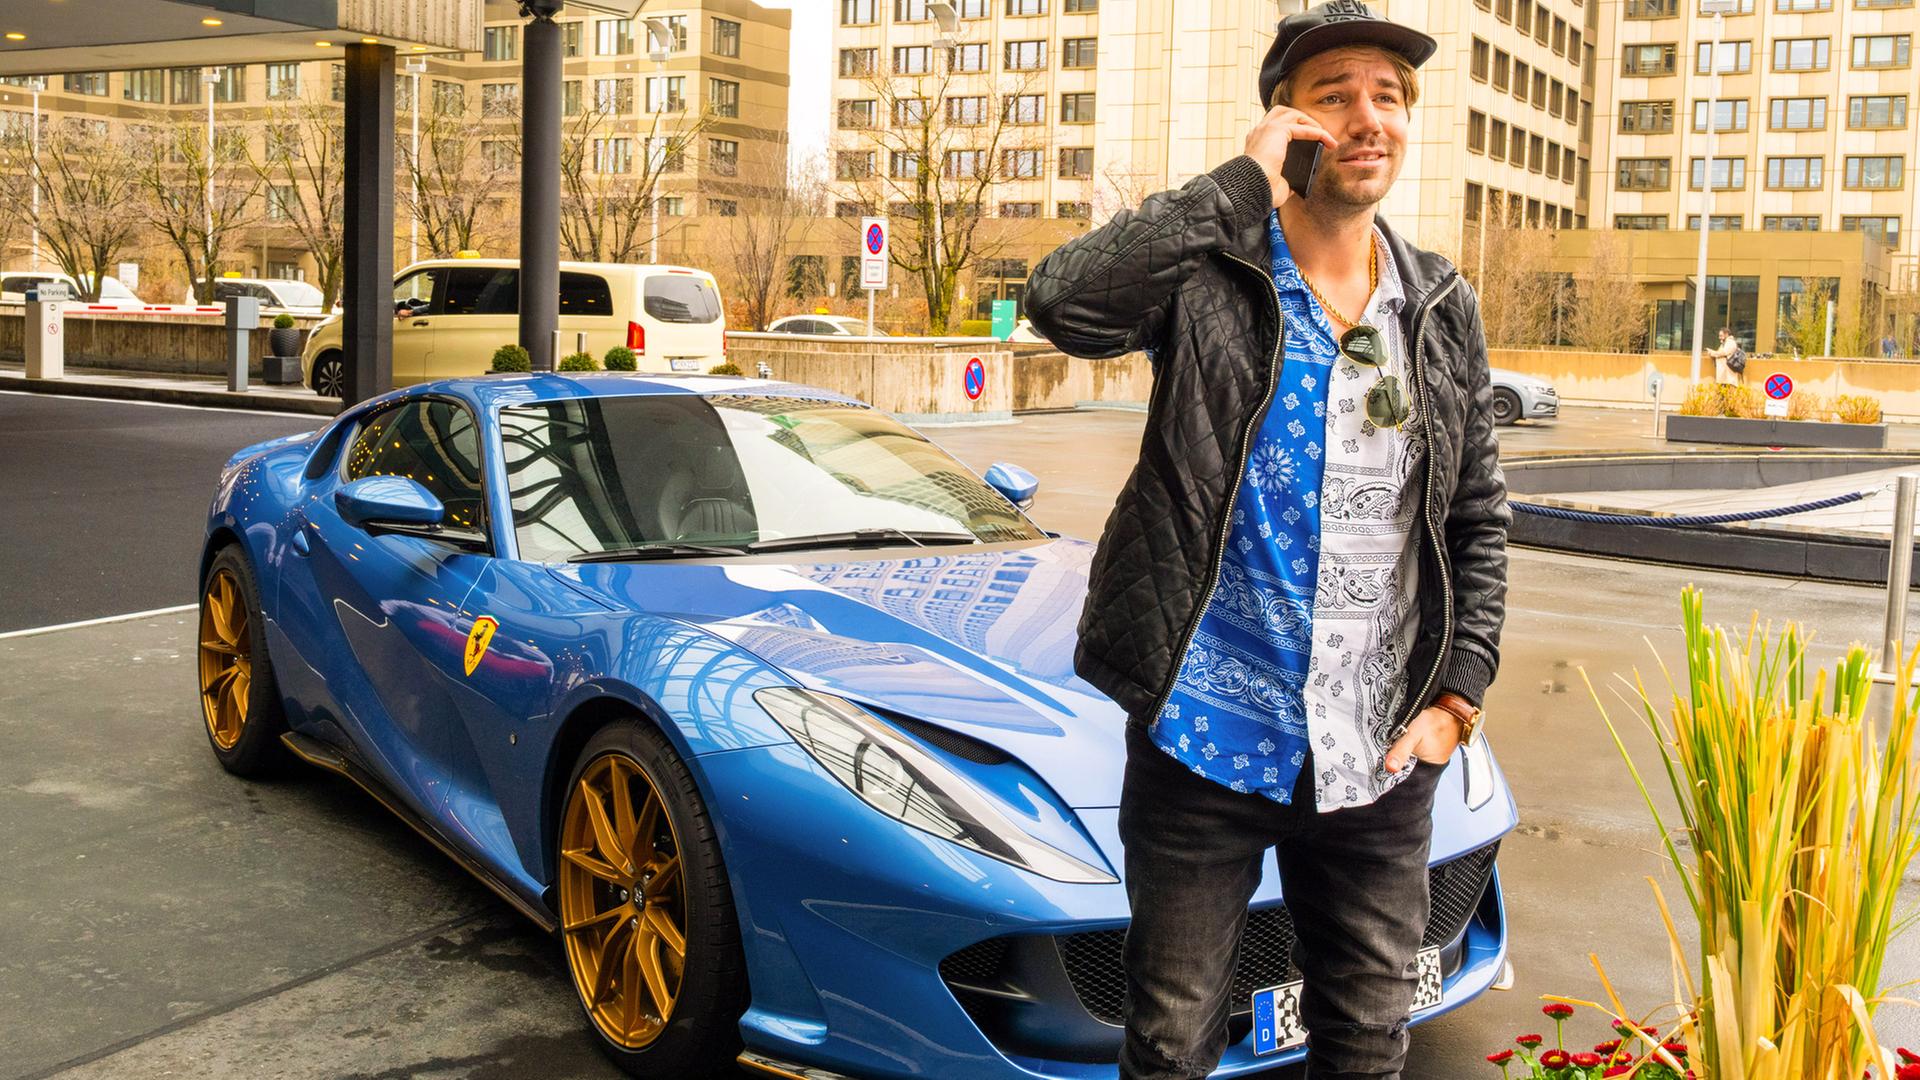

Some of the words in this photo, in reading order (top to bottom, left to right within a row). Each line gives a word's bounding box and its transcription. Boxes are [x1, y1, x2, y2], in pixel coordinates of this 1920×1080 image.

[1326, 0, 1368, 15] NEW
[48, 289, 66, 297] Parking
[1262, 1028, 1270, 1042] D
